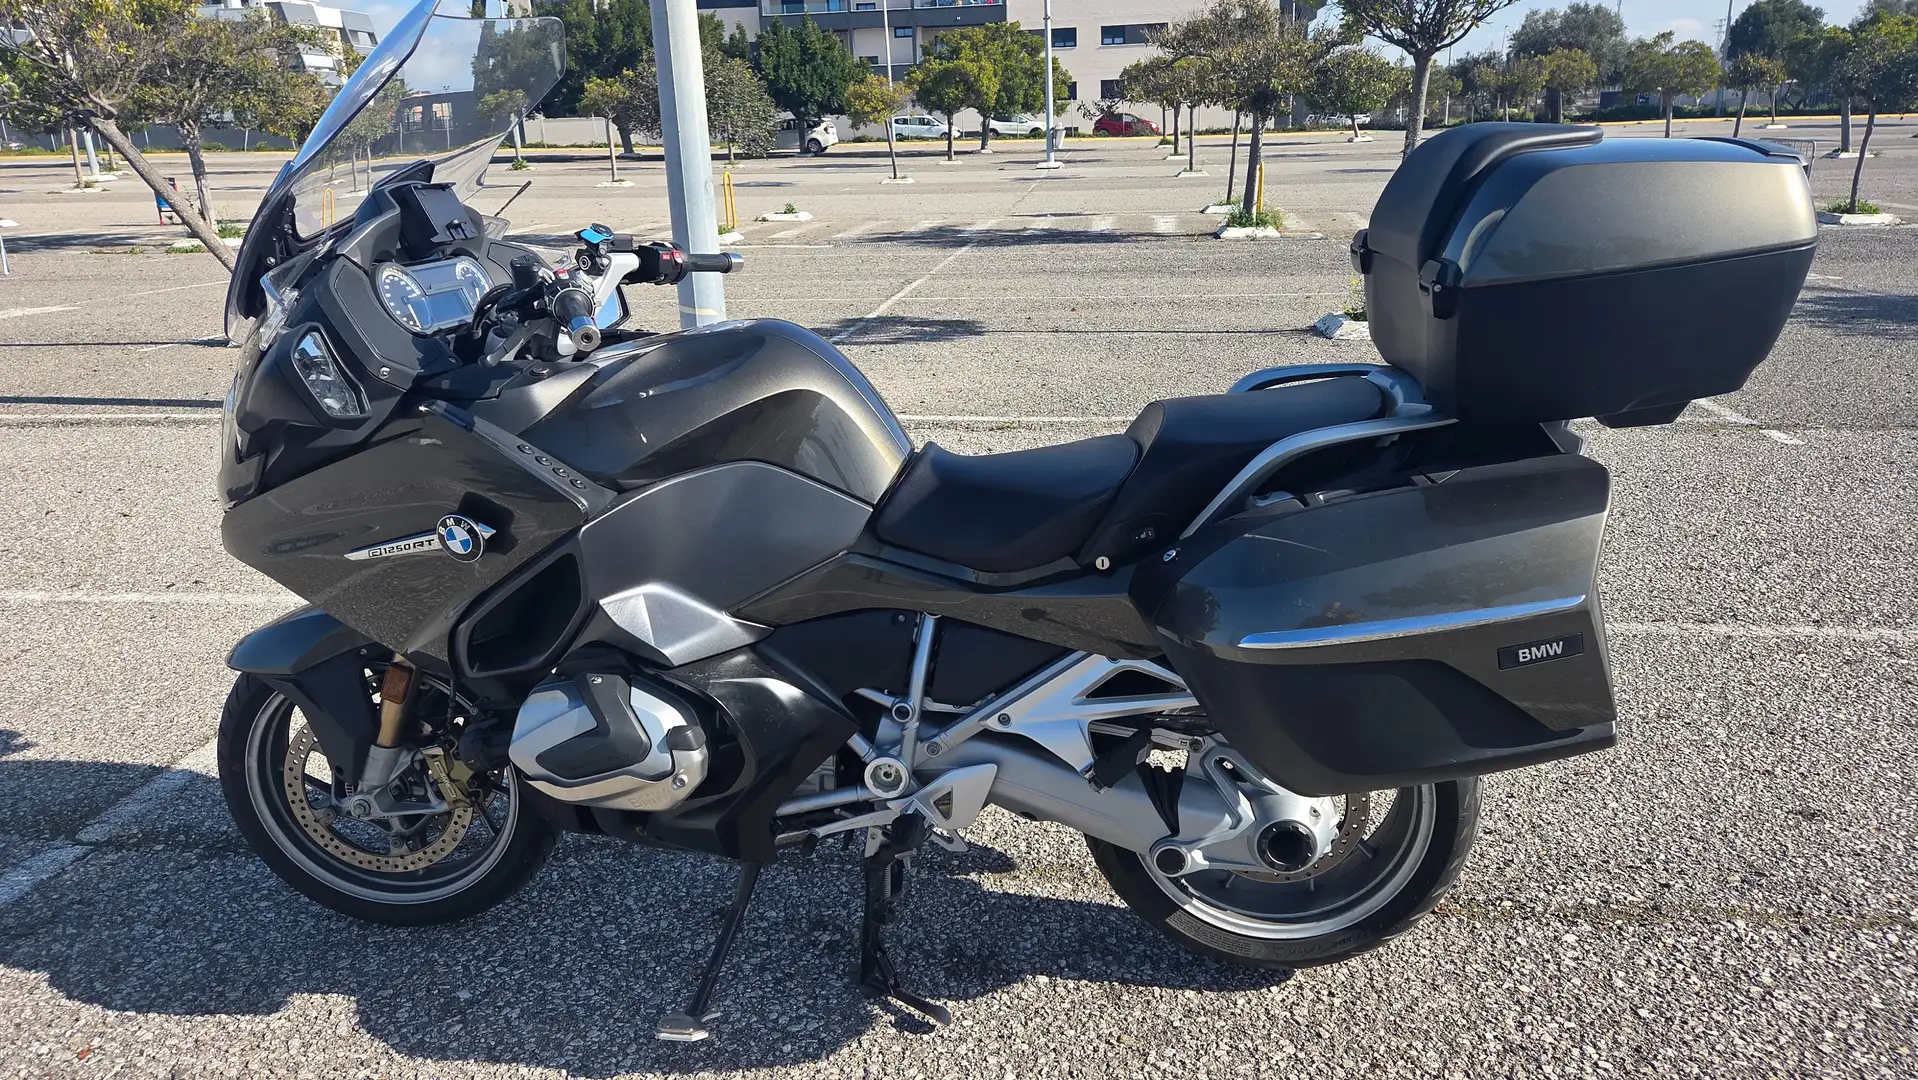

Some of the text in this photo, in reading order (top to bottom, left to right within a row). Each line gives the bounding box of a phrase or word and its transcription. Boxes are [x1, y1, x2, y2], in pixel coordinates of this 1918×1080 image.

[439, 517, 470, 535] BMW
[1518, 641, 1563, 662] BMW
[628, 787, 671, 808] BMW
